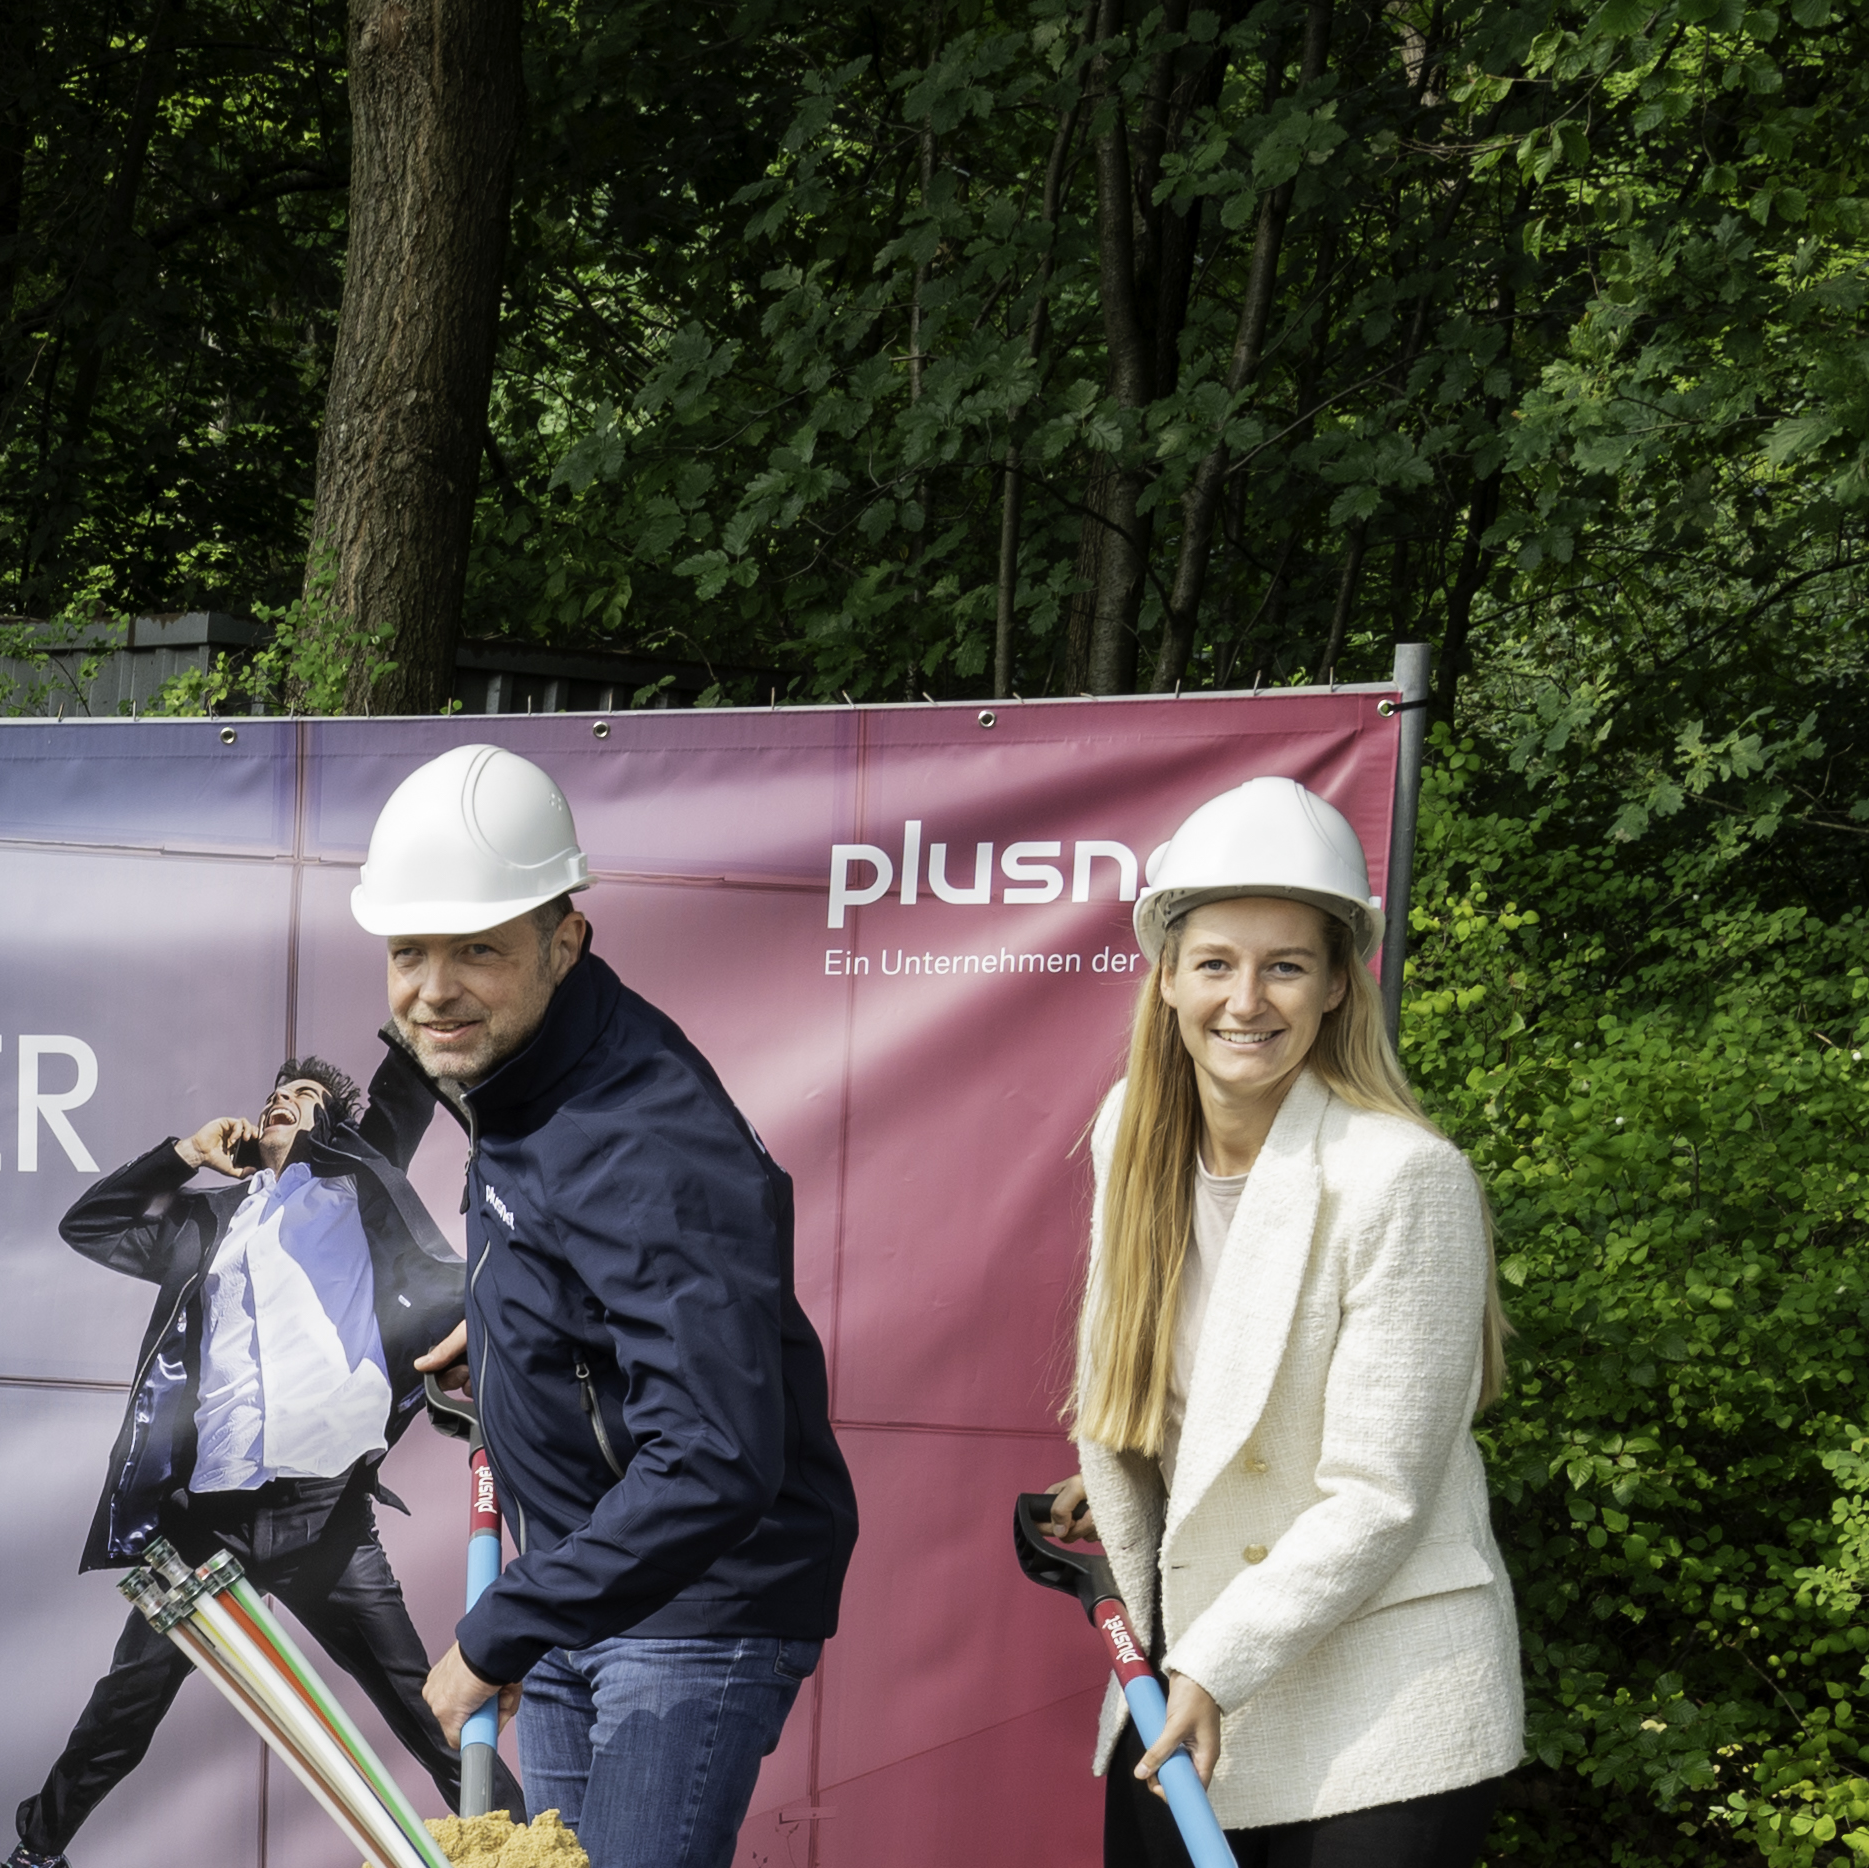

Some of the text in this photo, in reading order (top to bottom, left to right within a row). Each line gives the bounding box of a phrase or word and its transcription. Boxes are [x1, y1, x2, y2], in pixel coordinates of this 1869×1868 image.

[824, 946, 1140, 976] Ein Unternehmen der
[1102, 1614, 1145, 1664] plusnet
